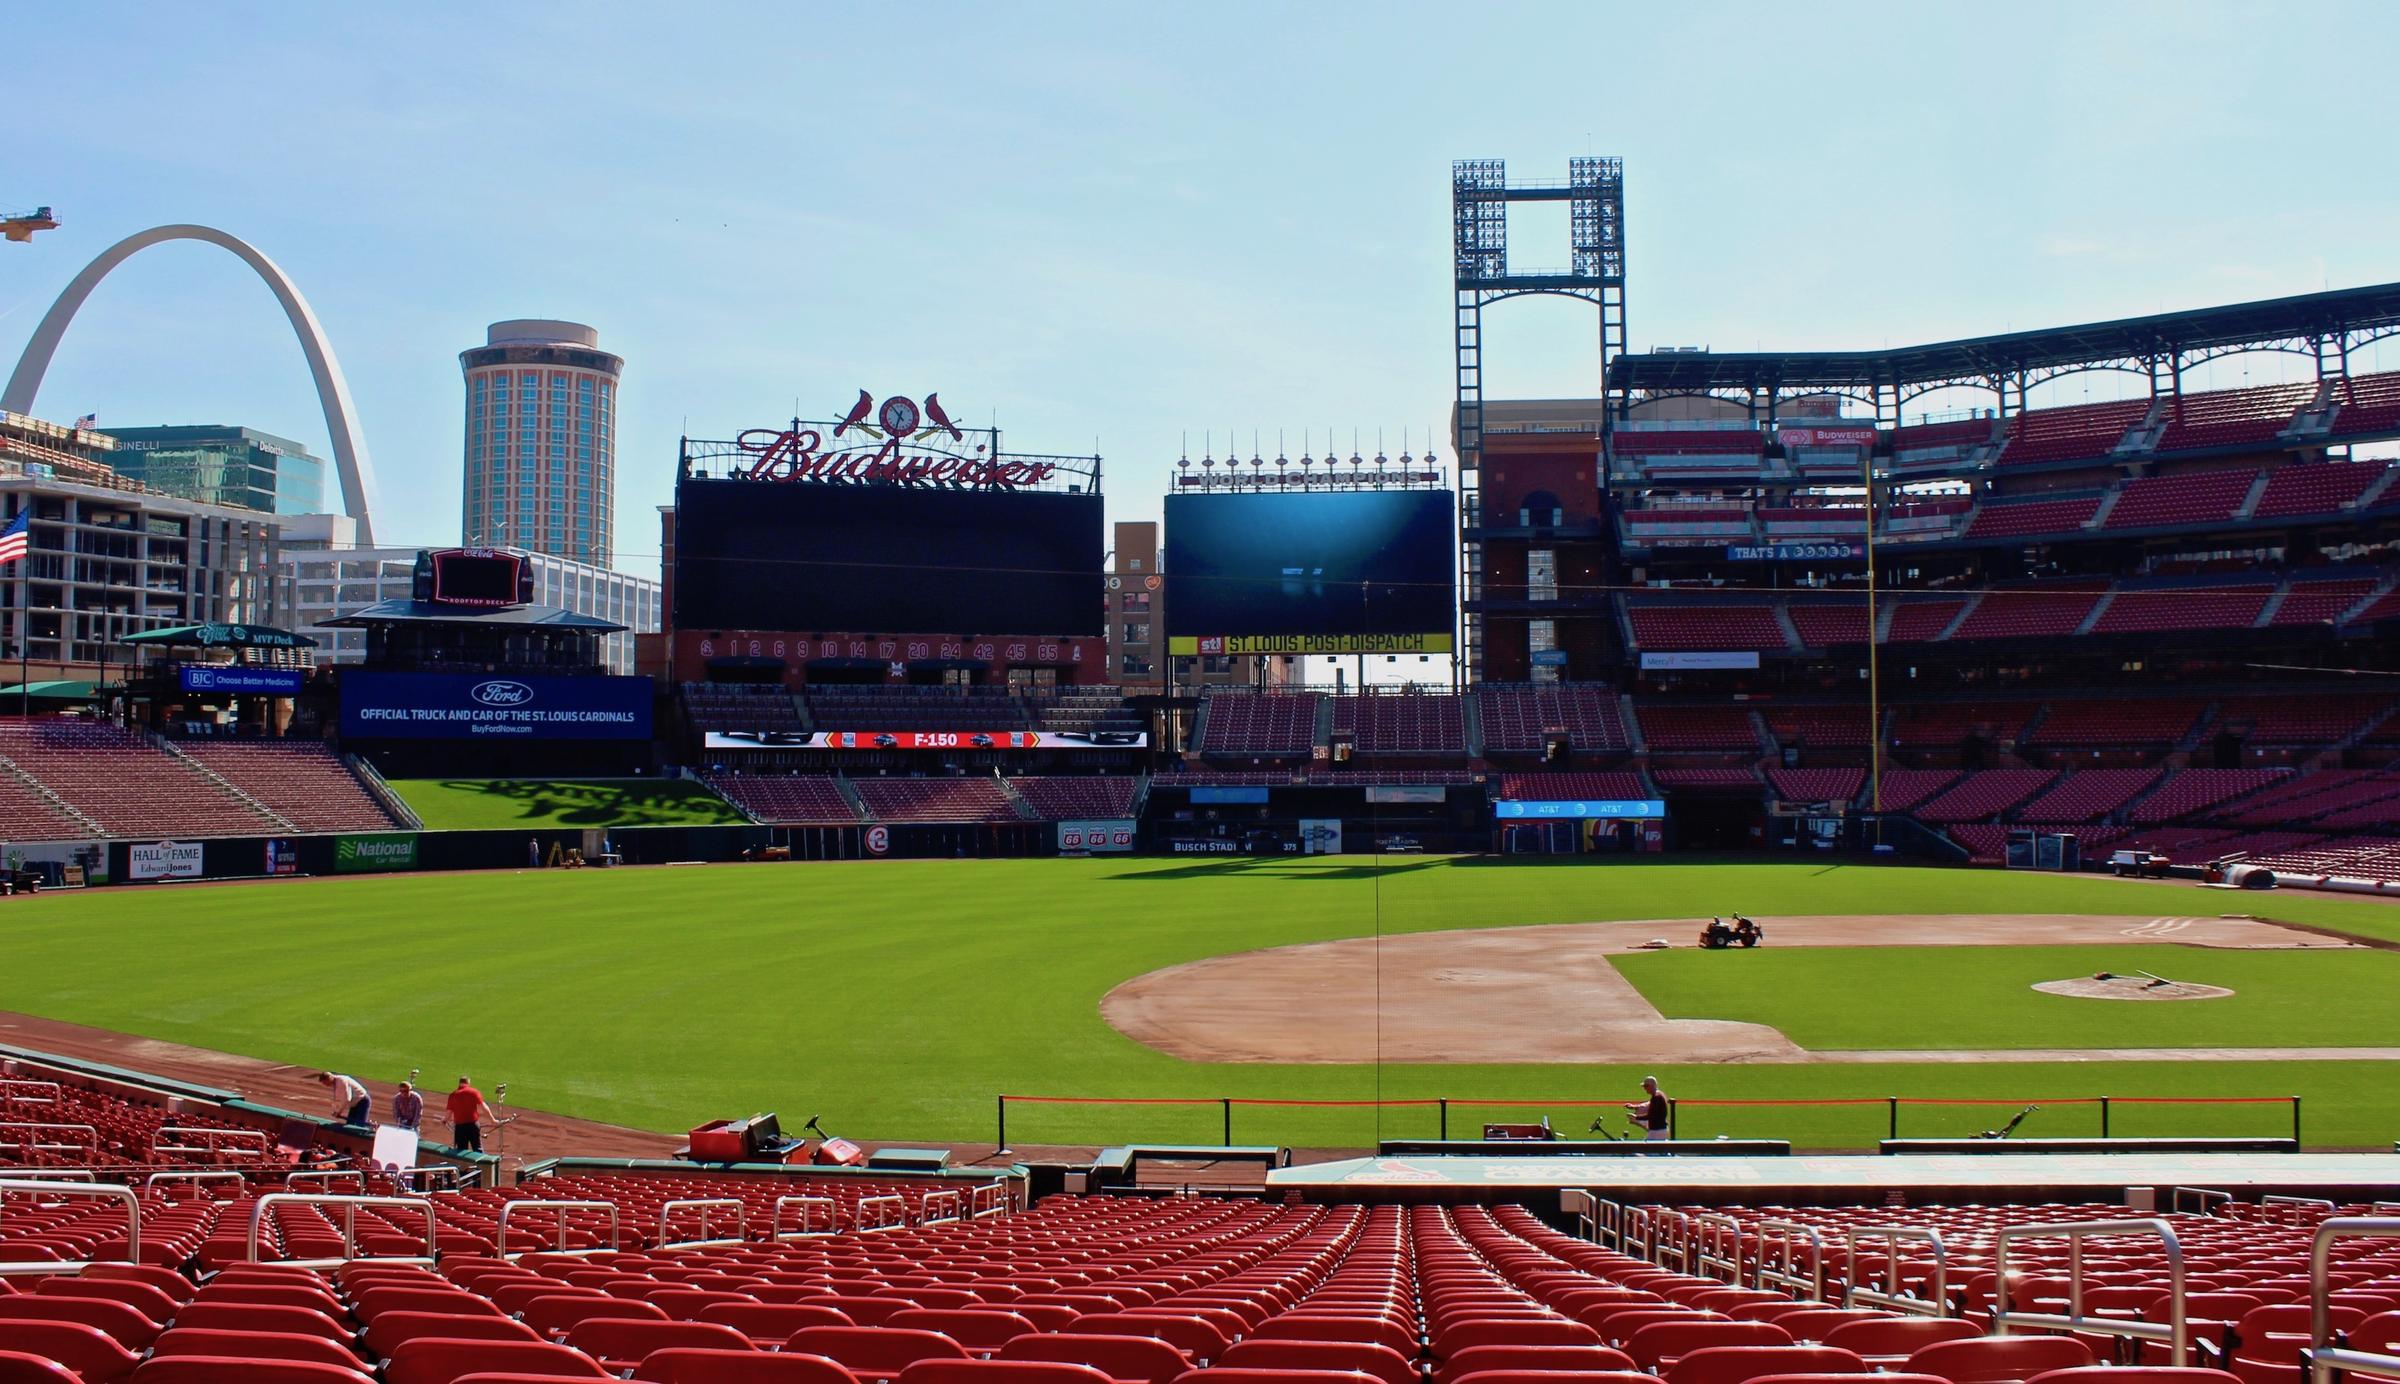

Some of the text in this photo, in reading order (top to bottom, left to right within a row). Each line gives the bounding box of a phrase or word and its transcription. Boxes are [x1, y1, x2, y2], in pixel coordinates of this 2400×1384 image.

[1817, 431, 1873, 439] BUDWEISER
[737, 429, 1056, 486] Budweiser
[1198, 471, 1422, 487] WORLD CHAMPIONS
[1735, 547, 1774, 559] THAT'S
[1780, 547, 1788, 558] A
[253, 635, 293, 646] MVP Deck
[1201, 637, 1222, 650] stl
[1229, 634, 1424, 651] ST. LOUIS POST-DISPATCH
[731, 640, 737, 656] 1
[750, 640, 760, 657] 2
[774, 641, 785, 657] 6
[797, 641, 808, 658] 9
[821, 641, 837, 658] 10
[850, 641, 866, 659] 14
[879, 642, 896, 659] 17
[908, 643, 928, 660] 20
[940, 643, 961, 660] 24
[974, 644, 994, 660] 42
[1006, 645, 1025, 661] 45
[1038, 645, 1058, 661] 85
[192, 673, 211, 685] BJC
[216, 676, 294, 687] Choose Better Medicine
[482, 683, 523, 701] Ford
[360, 708, 635, 722] OFFICIAL TRUCK AND CAR OF THE ST. LOUIS CARDINALS
[471, 724, 532, 733] BuyFordNow.com
[914, 733, 957, 746] F-150
[1538, 805, 1622, 814] AT&T AT&T
[1065, 834, 1129, 844] 66 66 66
[355, 841, 413, 856] National
[1174, 842, 1252, 851] BUSCH STADIM
[1283, 843, 1297, 851] 375
[133, 849, 162, 861] HALL
[172, 849, 200, 860] FAME
